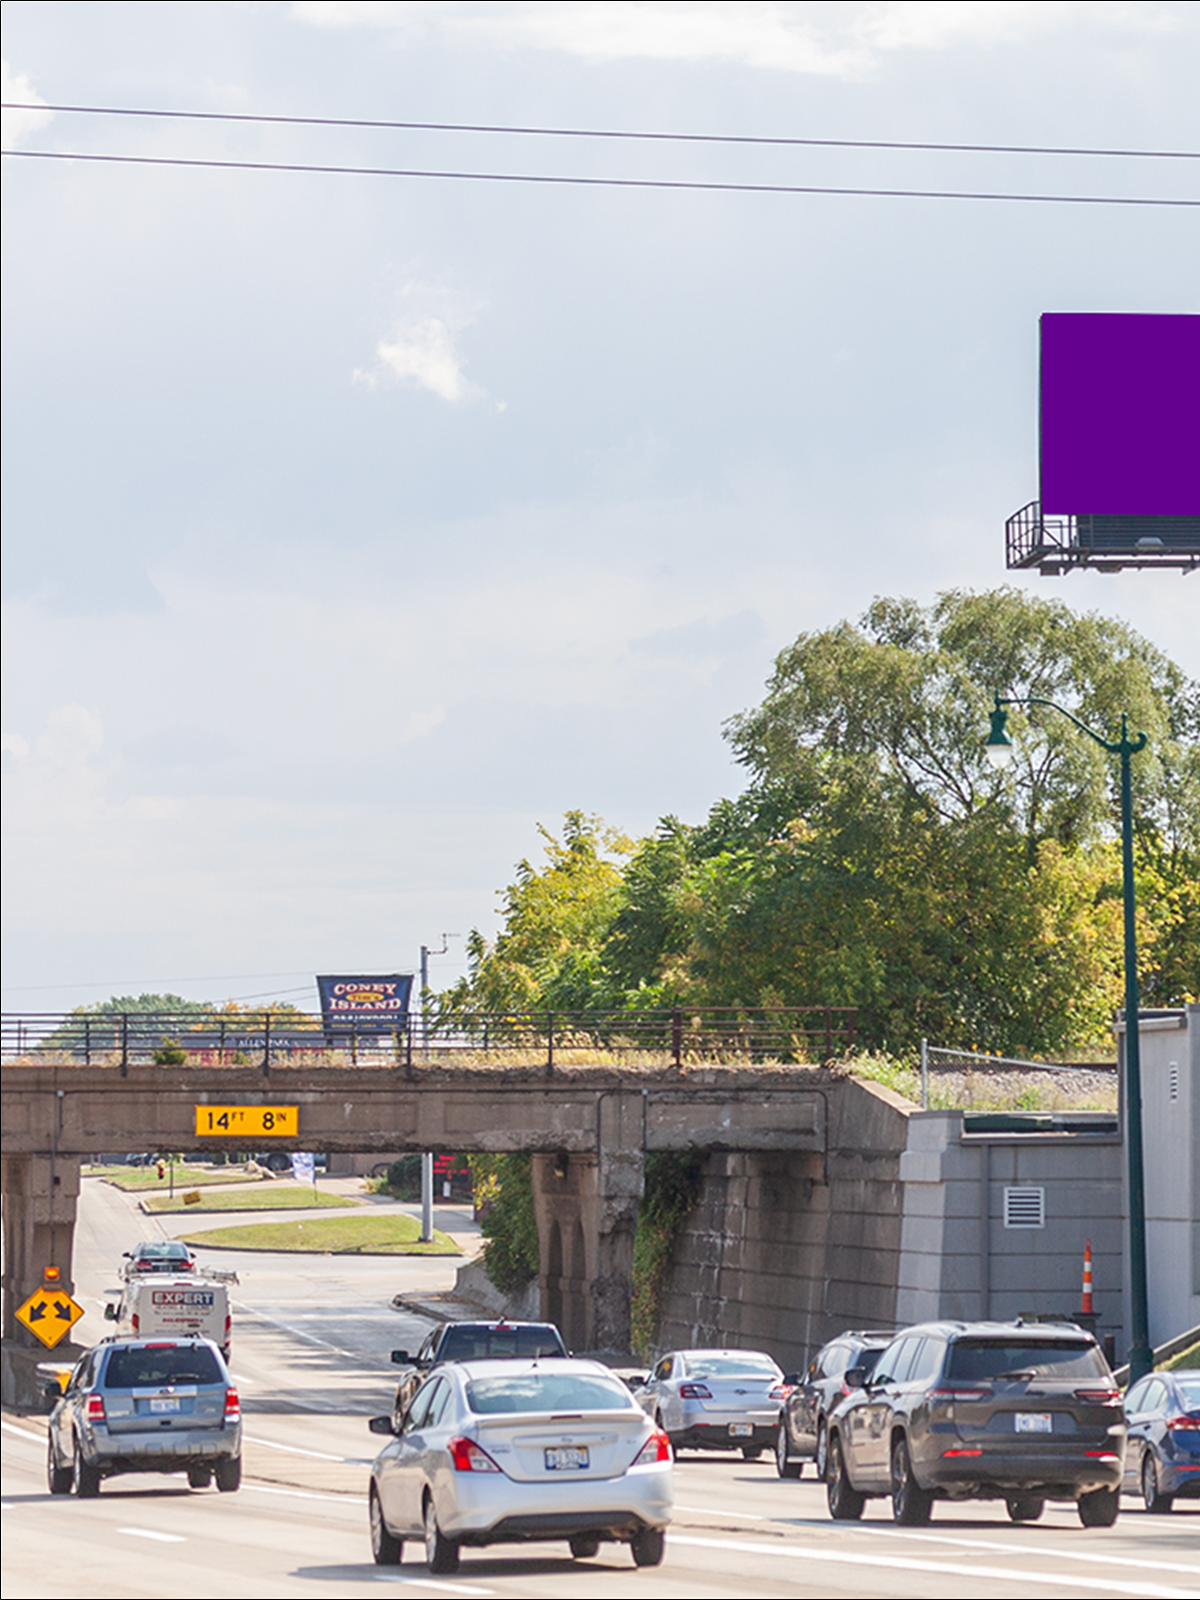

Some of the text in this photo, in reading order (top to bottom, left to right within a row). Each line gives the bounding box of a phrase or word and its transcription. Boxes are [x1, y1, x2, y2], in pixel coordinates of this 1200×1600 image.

[333, 983, 397, 996] CONEY
[329, 997, 402, 1012] ISLAND
[154, 1292, 212, 1304] EXPERT
